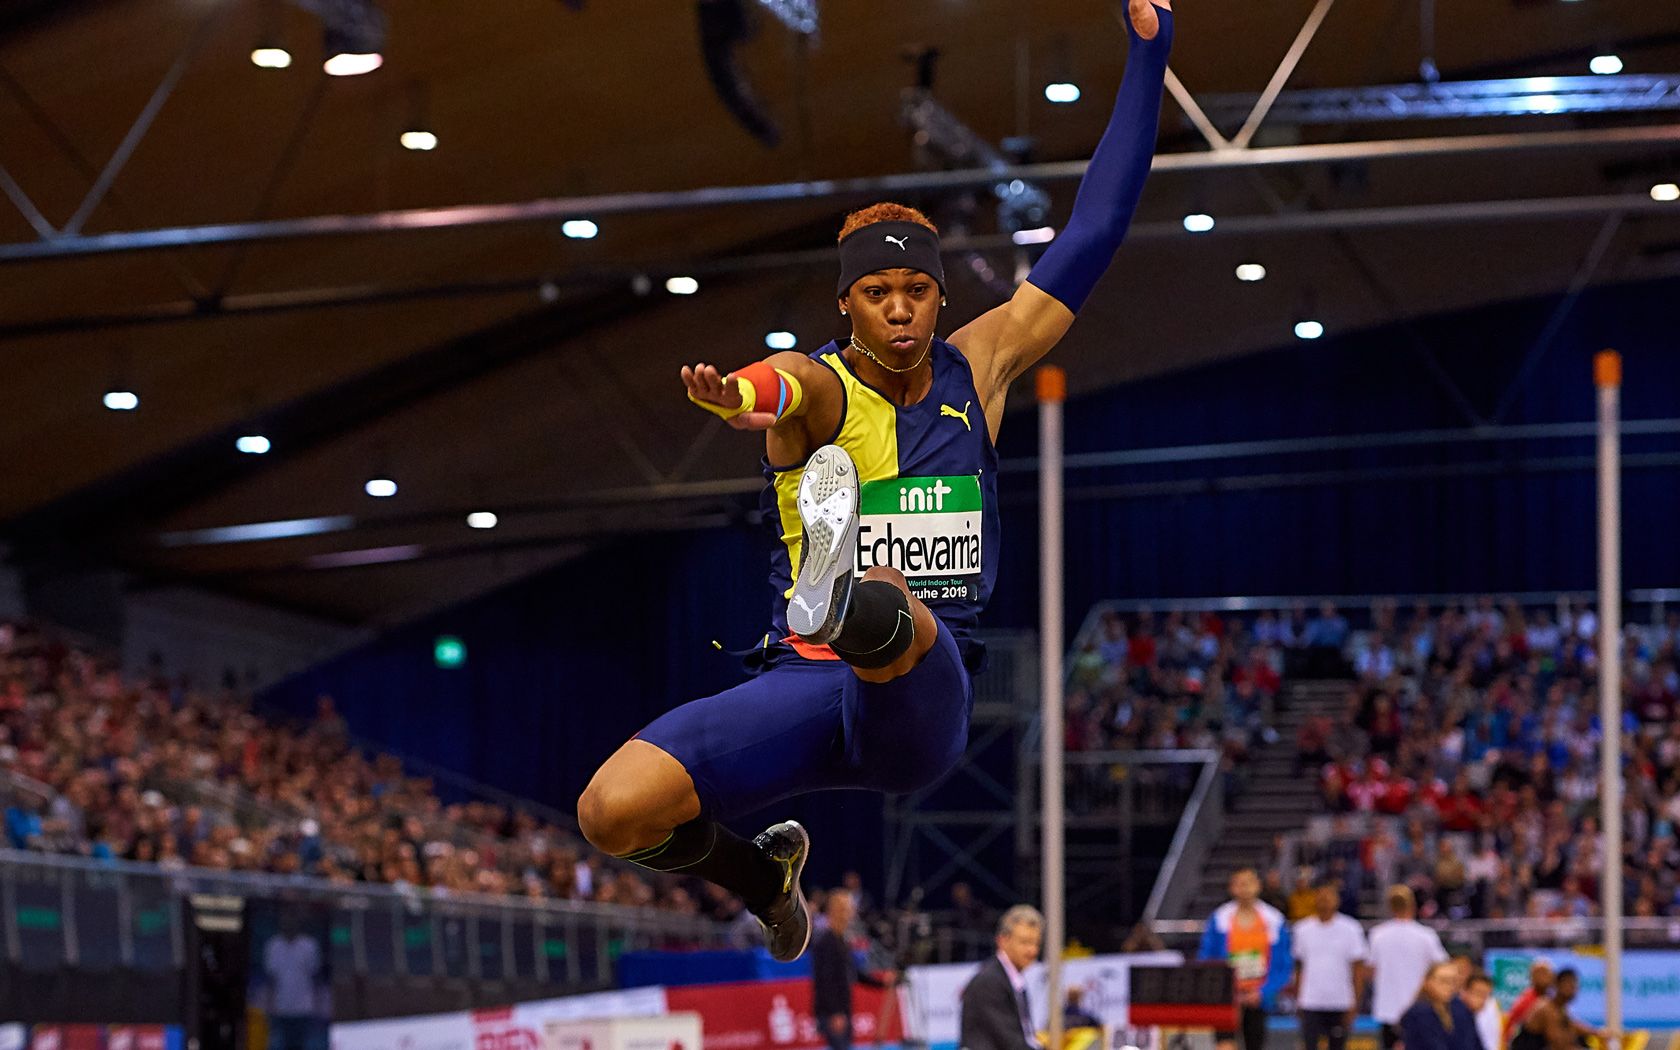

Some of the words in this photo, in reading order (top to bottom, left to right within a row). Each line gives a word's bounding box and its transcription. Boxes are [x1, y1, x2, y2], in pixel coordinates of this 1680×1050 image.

[900, 479, 952, 512] init
[910, 588, 939, 599] ruhe
[941, 586, 968, 599] 2019
